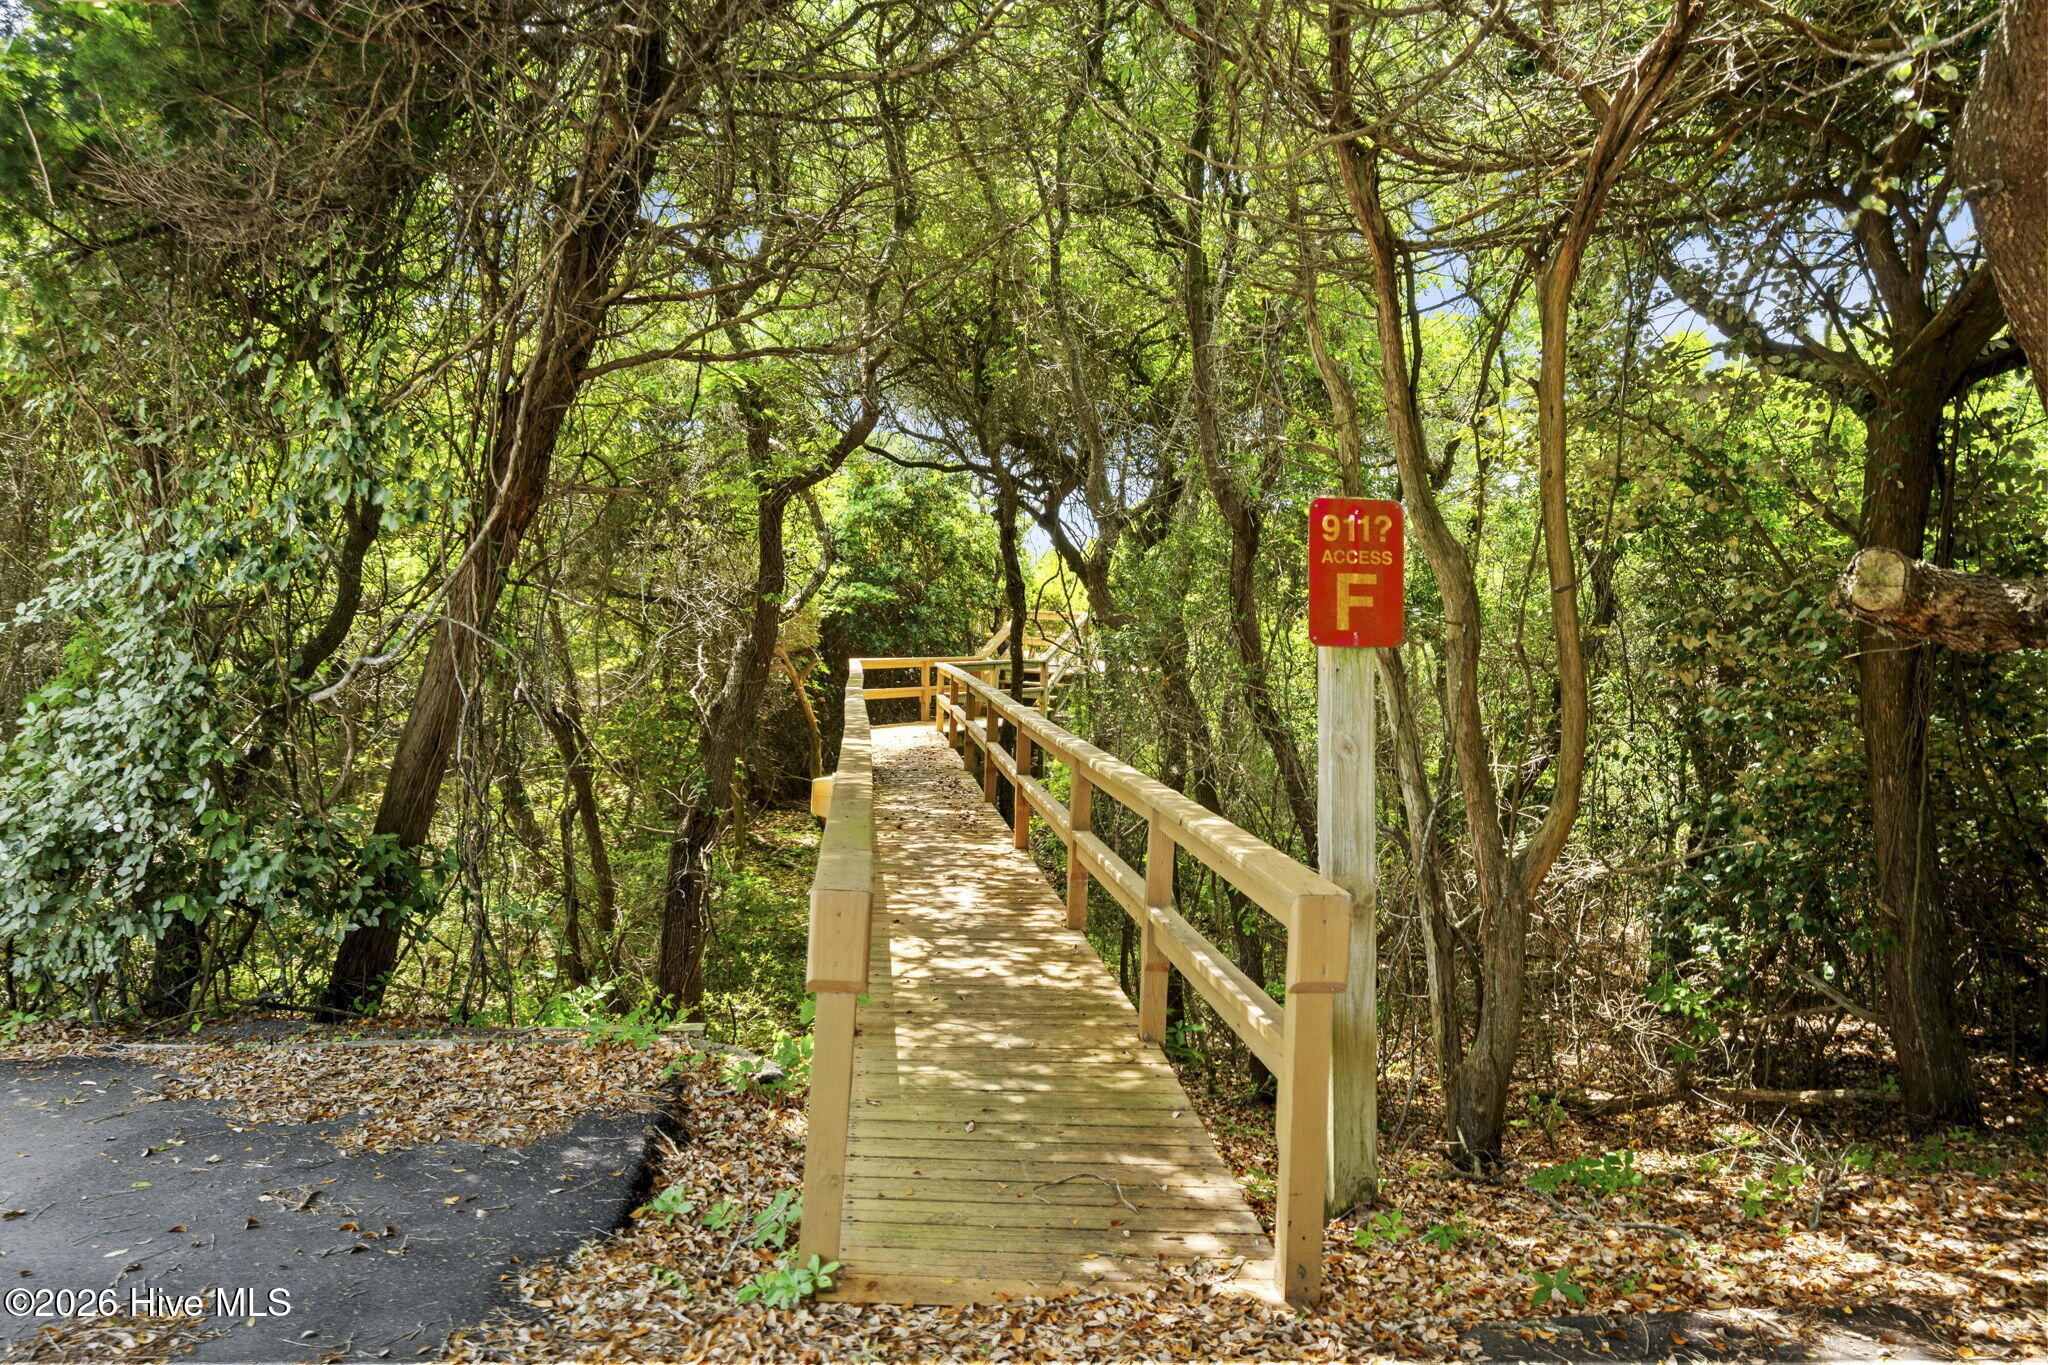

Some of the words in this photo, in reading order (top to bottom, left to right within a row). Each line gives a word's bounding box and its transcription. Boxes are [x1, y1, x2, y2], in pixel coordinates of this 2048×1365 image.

[1321, 514, 1393, 543] 911?
[1321, 549, 1393, 565] ACCESS
[1336, 572, 1377, 631] F
